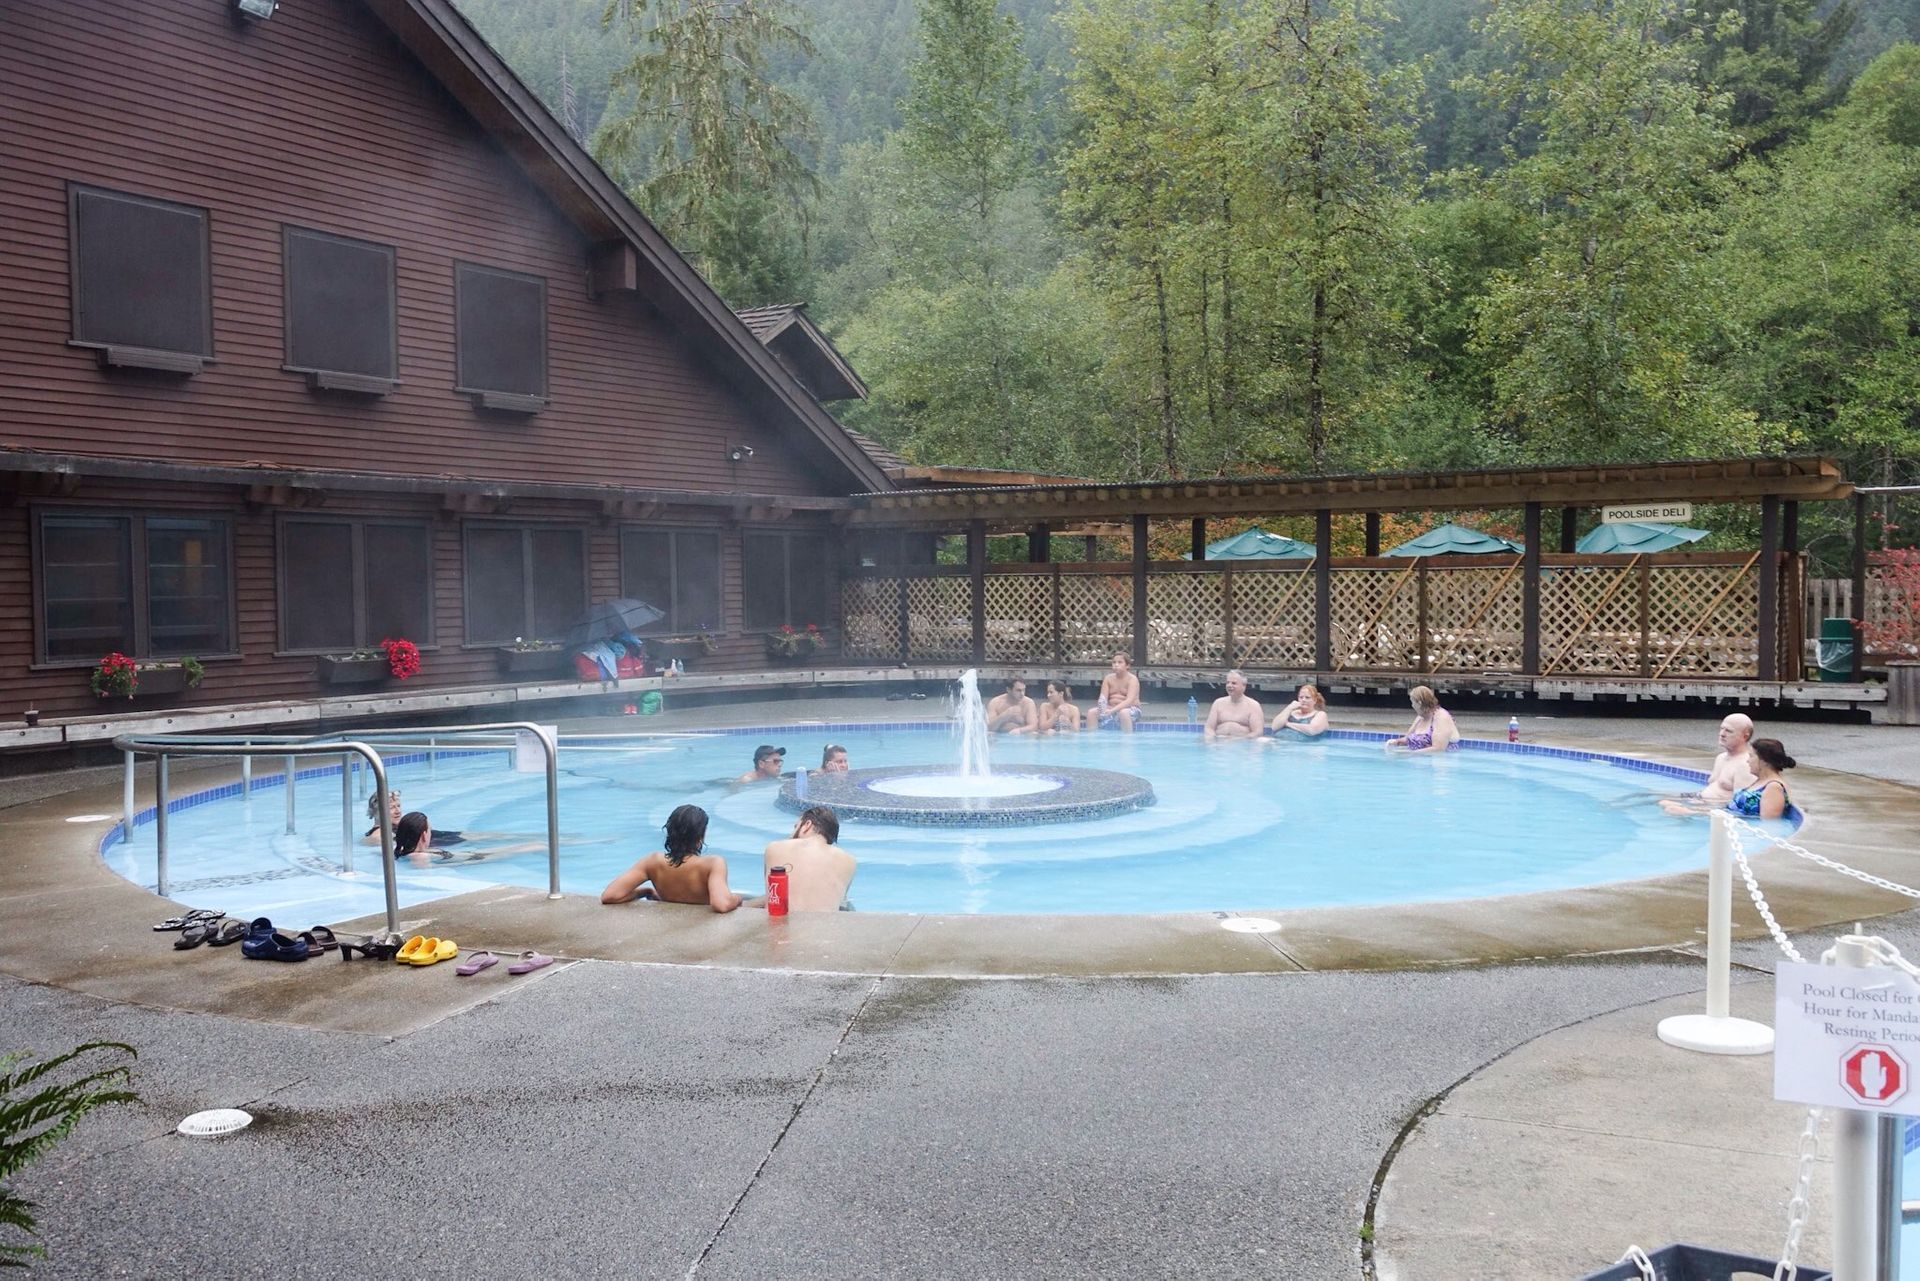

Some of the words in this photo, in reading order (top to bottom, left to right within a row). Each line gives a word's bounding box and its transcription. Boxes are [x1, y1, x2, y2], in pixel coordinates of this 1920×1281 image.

[1609, 509, 1659, 519] POOLSIDE
[1663, 508, 1686, 517] DELI
[1803, 983, 1835, 998] Pool
[1840, 987, 1888, 1003] Closed
[1893, 991, 1913, 1005] for
[1804, 1002, 1842, 1017] Hour
[1847, 1006, 1868, 1020] for
[1872, 1008, 1920, 1024] Manda
[1824, 1022, 1877, 1041] Resting
